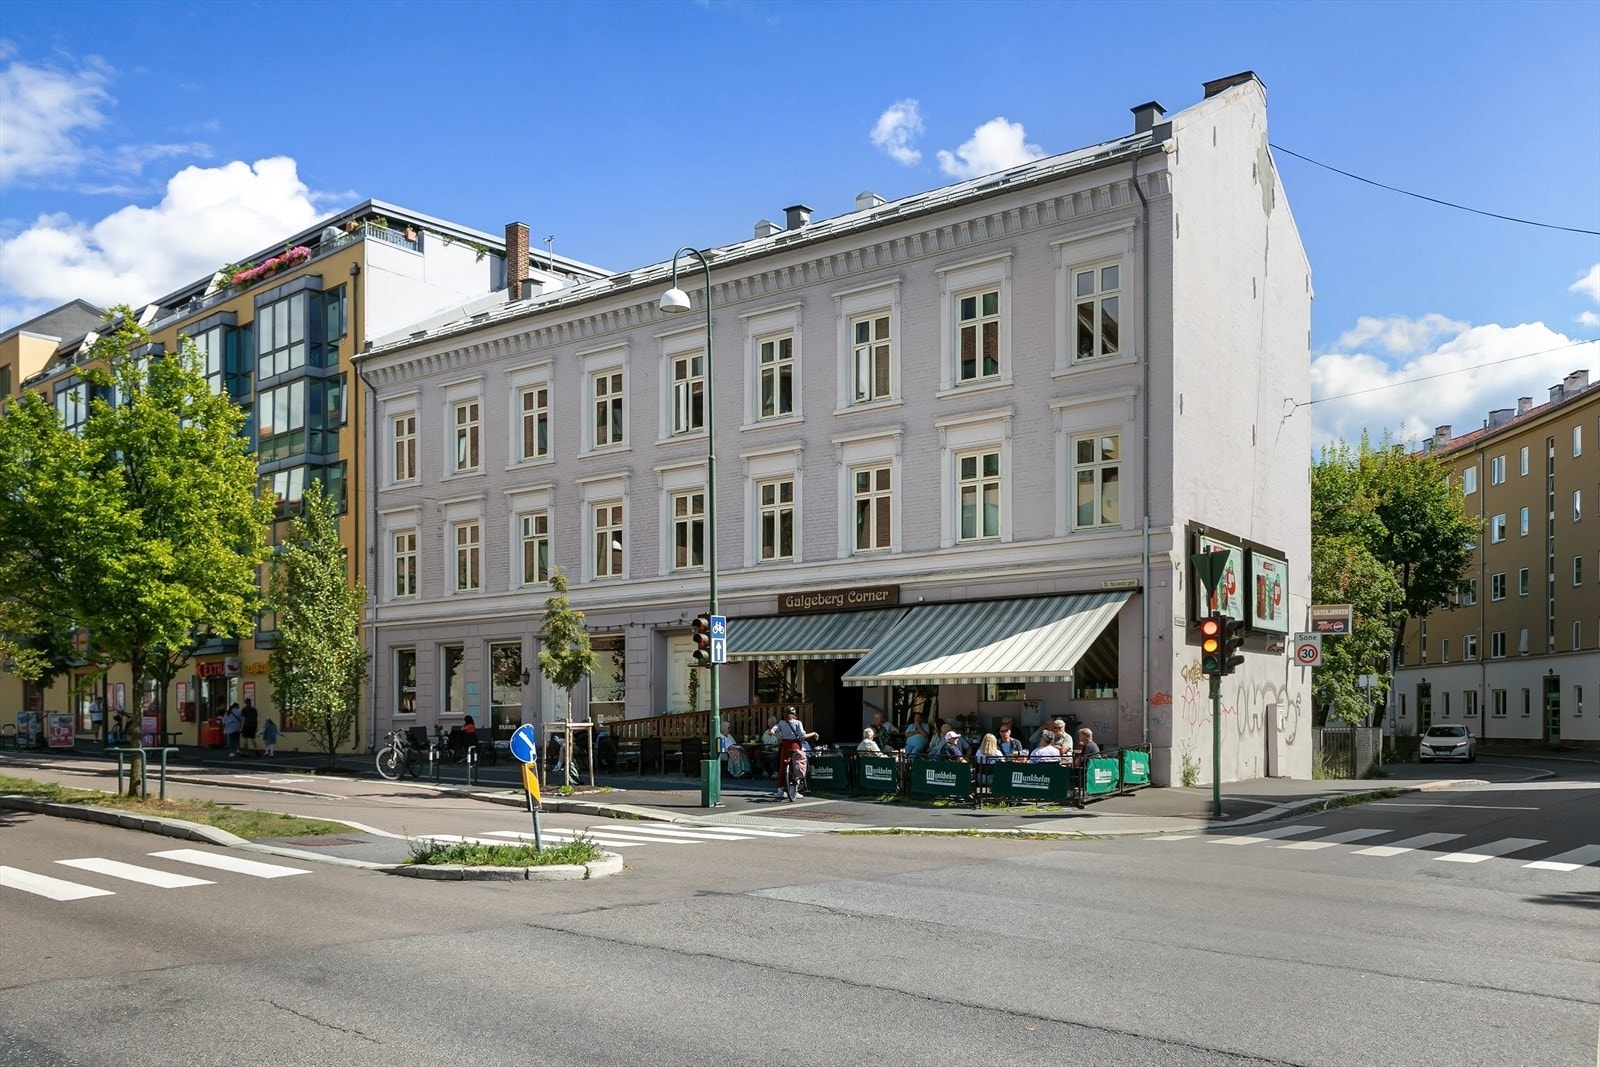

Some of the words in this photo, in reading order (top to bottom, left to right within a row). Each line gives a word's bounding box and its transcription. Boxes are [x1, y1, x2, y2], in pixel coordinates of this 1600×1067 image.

[786, 594, 844, 609] Galgeberg
[847, 591, 889, 603] Corner
[1301, 648, 1315, 659] 30
[865, 764, 893, 776] Munkholm
[926, 768, 957, 781] Munkholm
[1011, 771, 1051, 784] Munkholm
